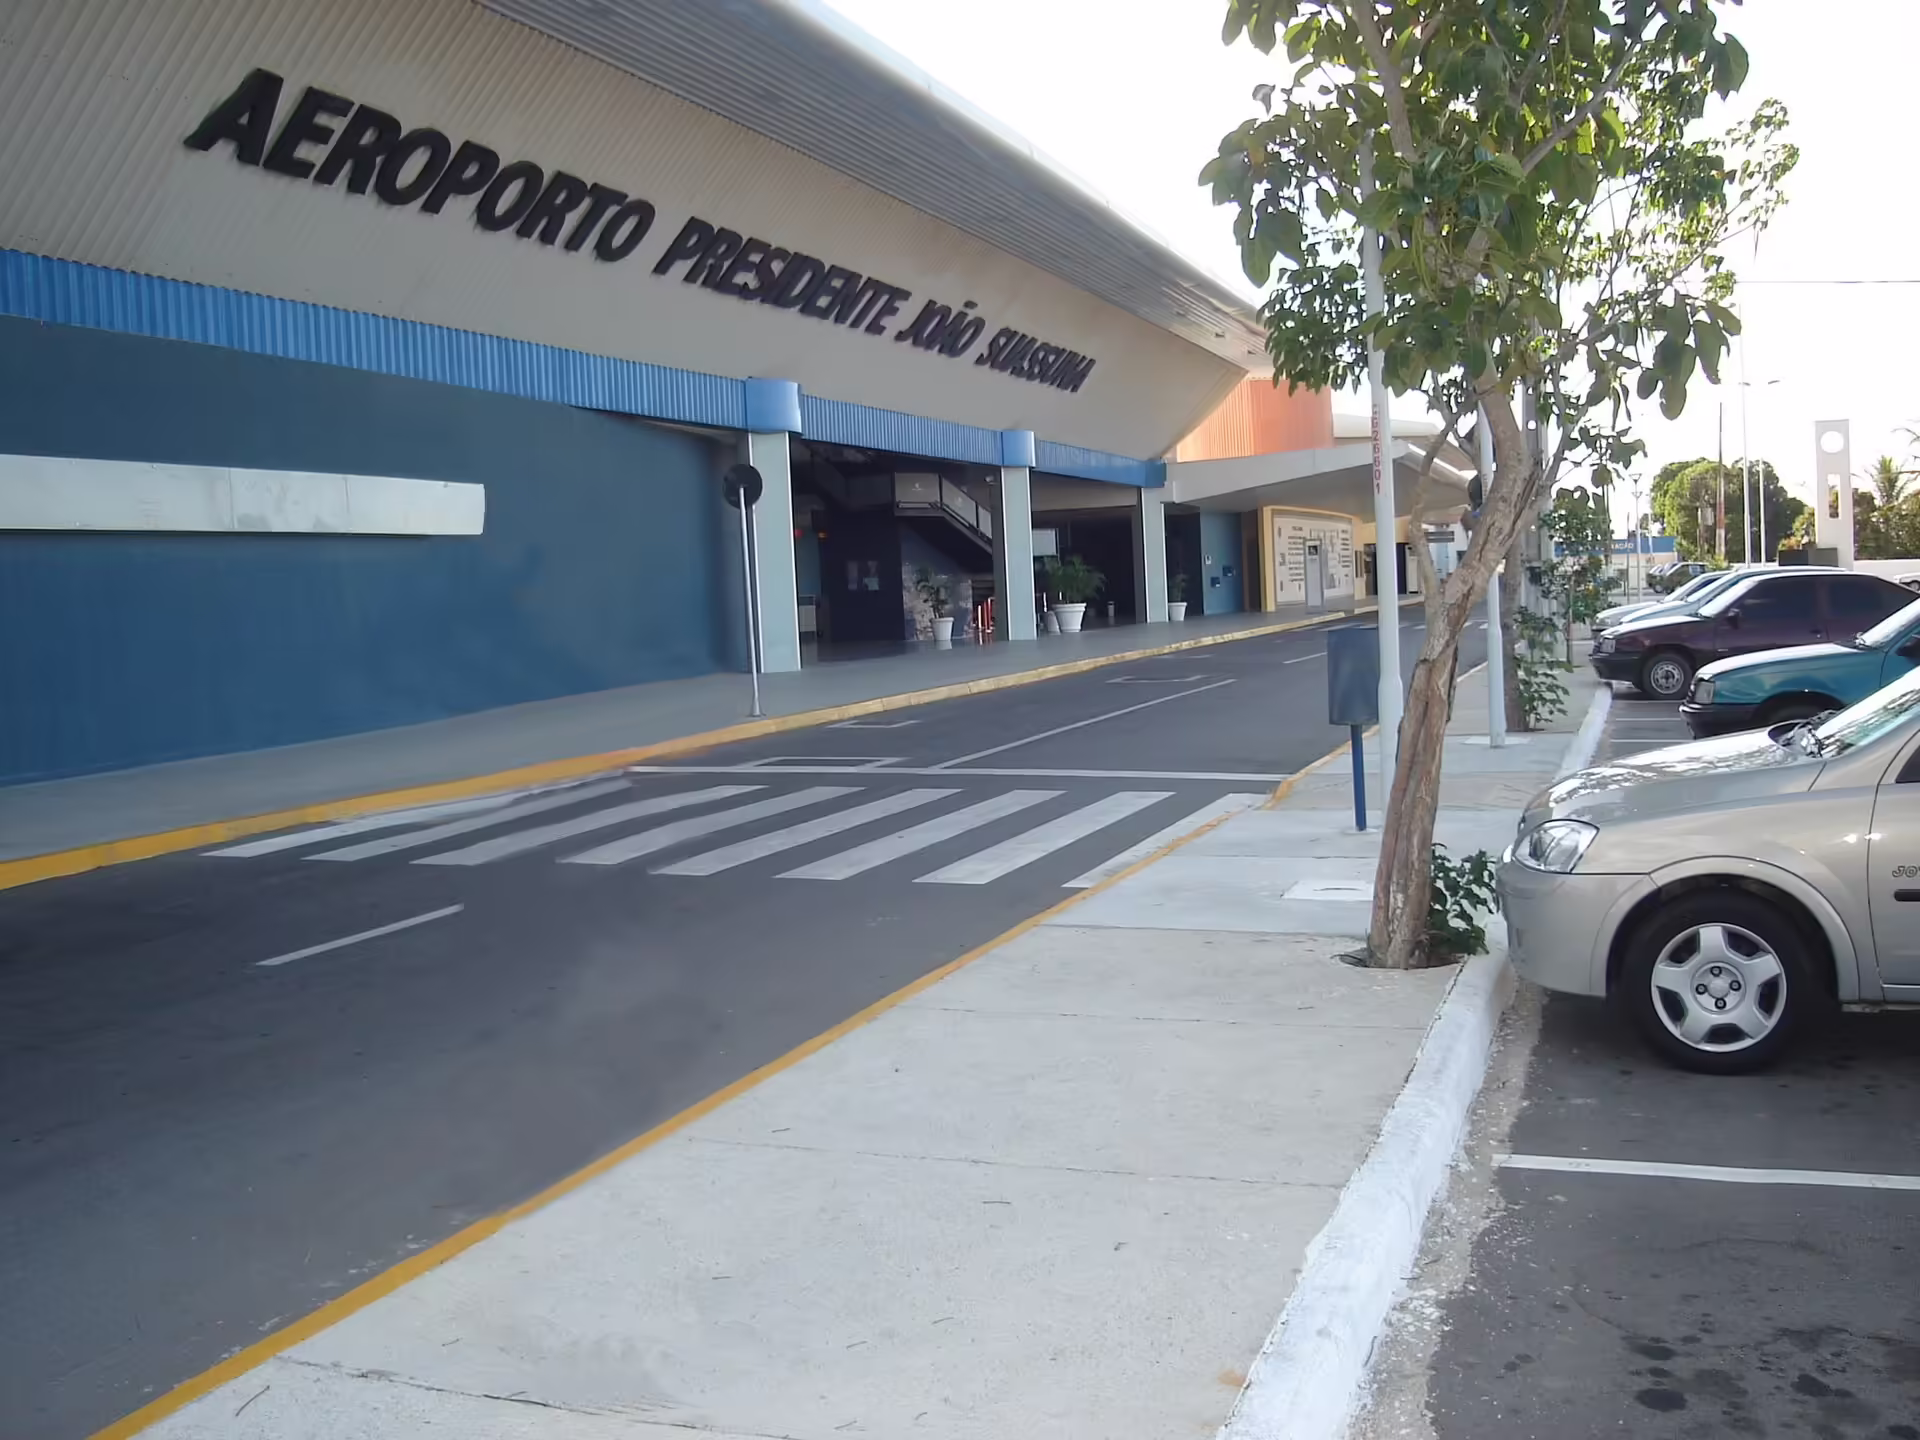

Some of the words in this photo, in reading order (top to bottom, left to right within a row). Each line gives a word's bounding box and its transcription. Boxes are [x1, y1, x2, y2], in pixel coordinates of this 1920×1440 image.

[183, 67, 655, 262] AEROPORTO
[652, 216, 912, 336] PRESIDENTE
[894, 299, 986, 358] JOÃO
[1892, 865, 1920, 878] JO
